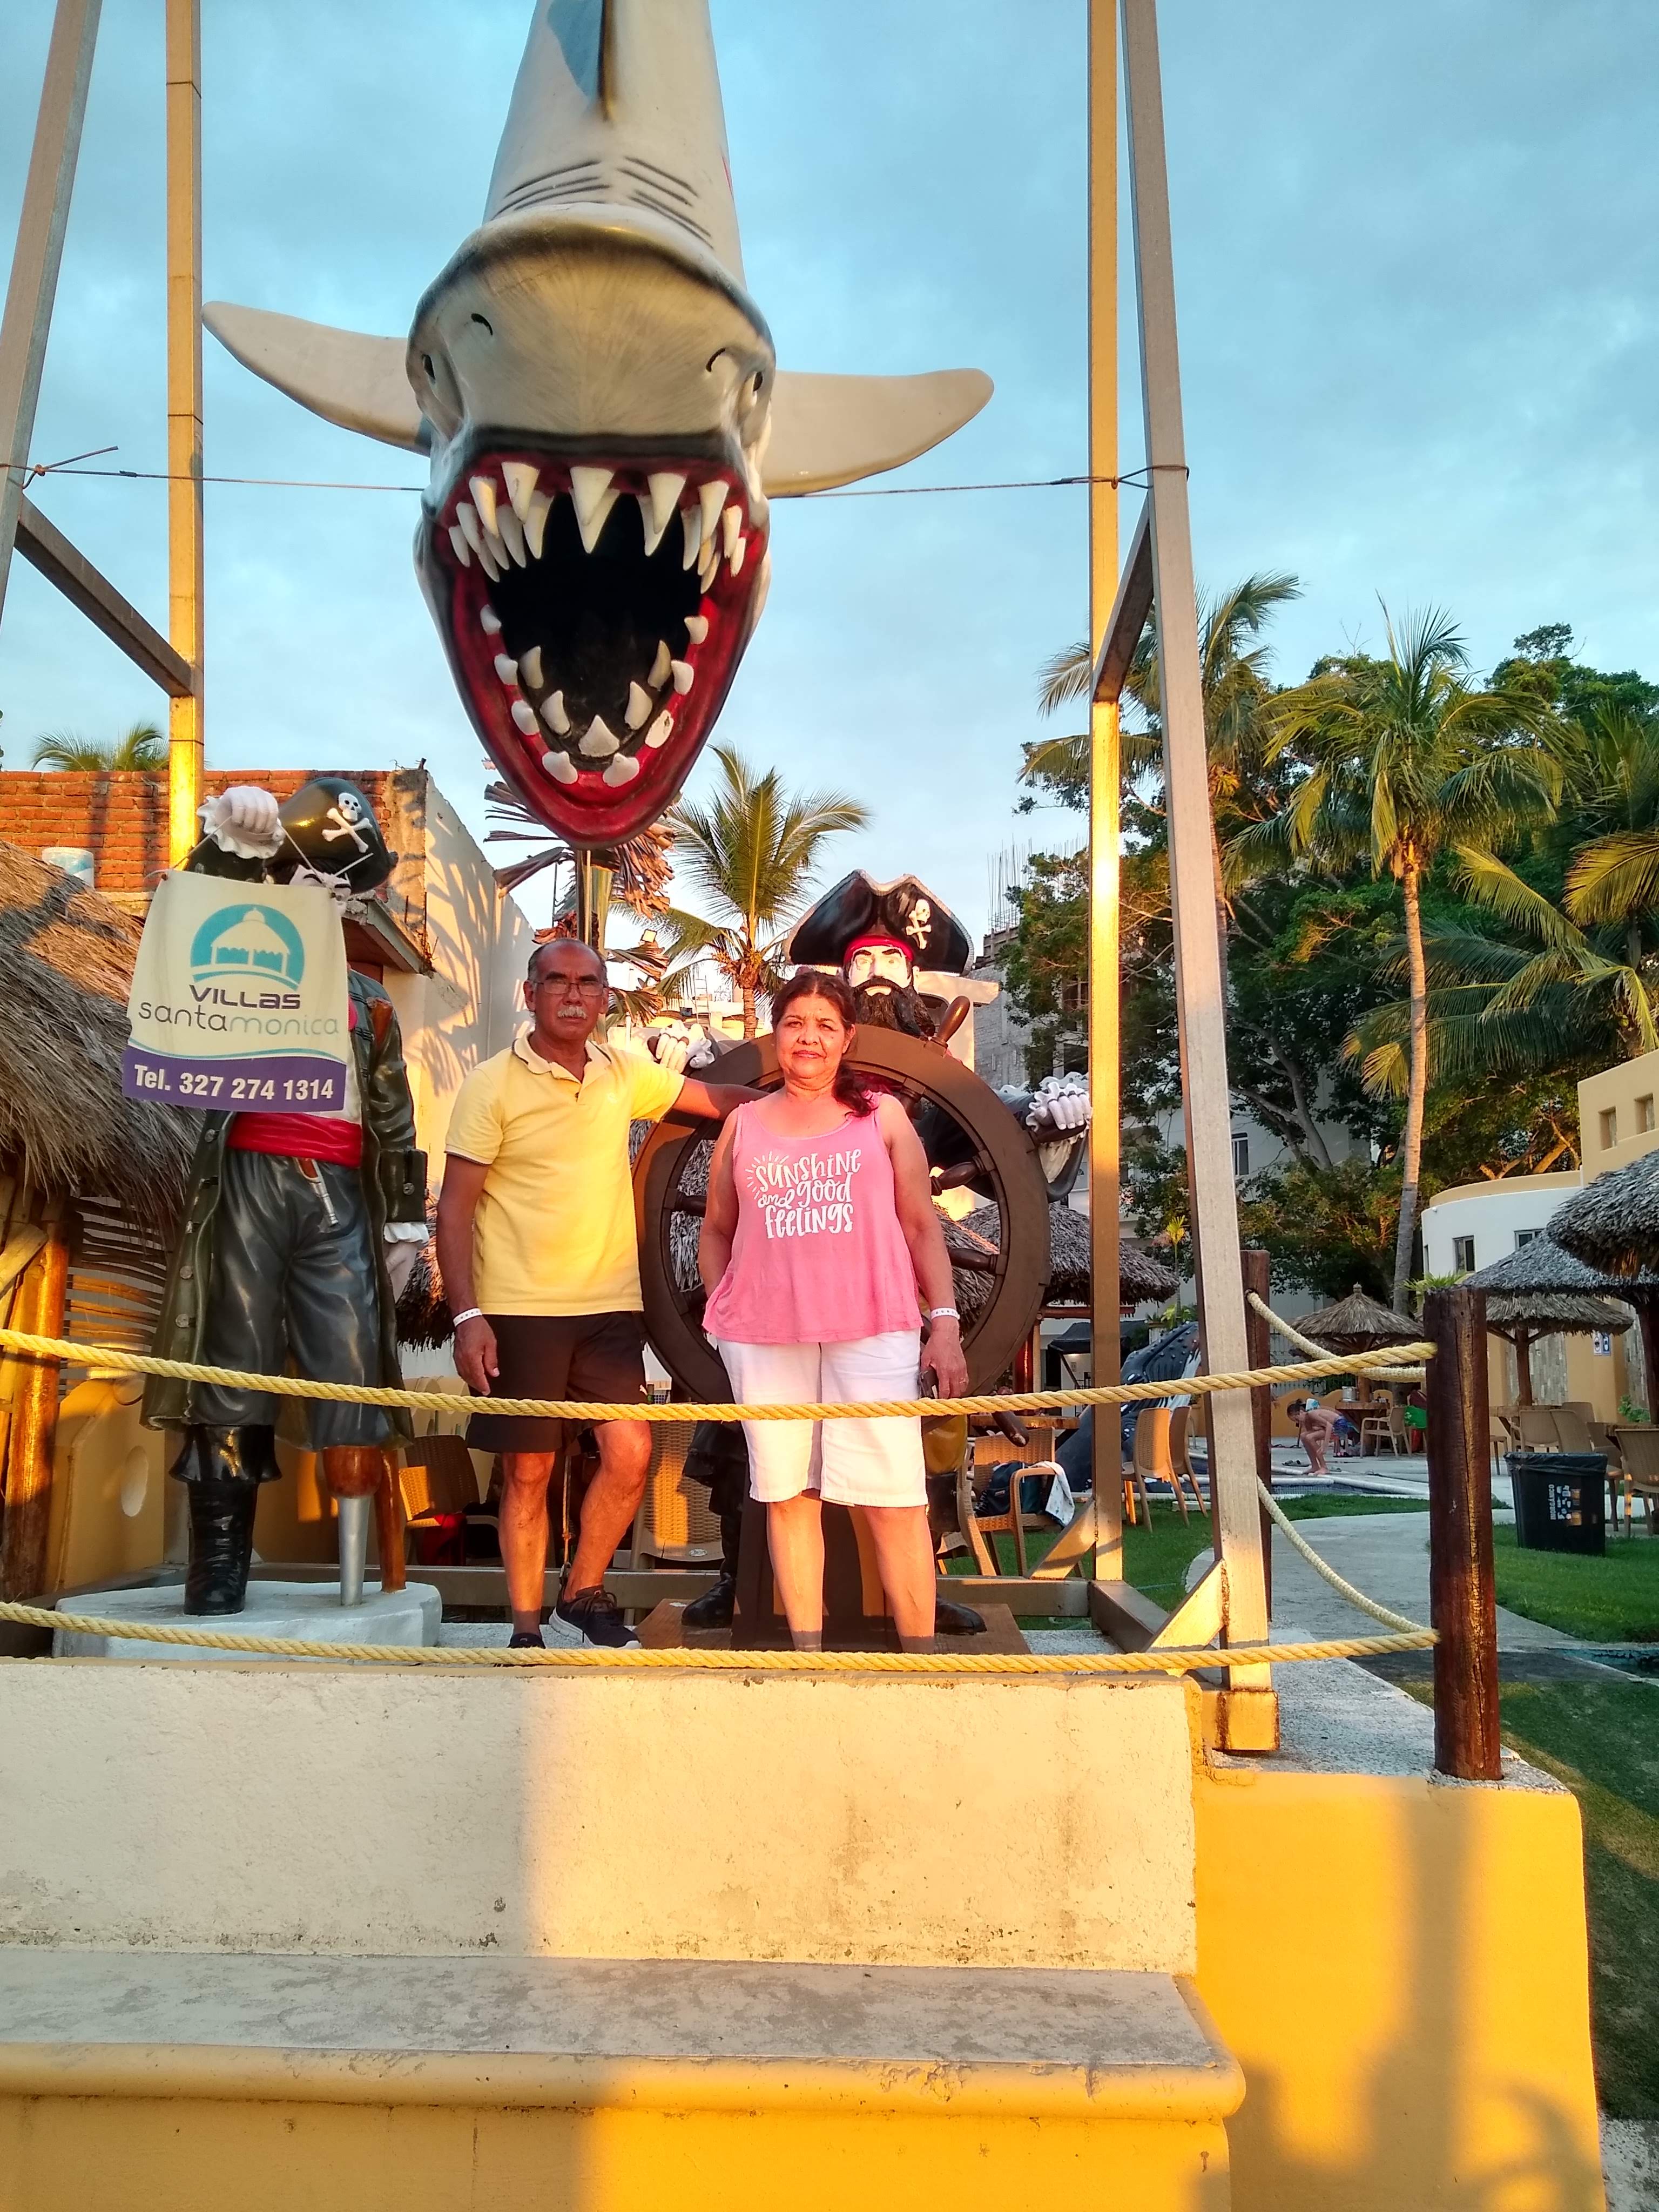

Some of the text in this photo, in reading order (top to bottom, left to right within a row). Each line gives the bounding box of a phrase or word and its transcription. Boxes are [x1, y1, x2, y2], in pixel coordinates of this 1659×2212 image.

[134, 1064, 333, 1100] Tel. 327 274 1314
[757, 1172, 853, 1210] and good
